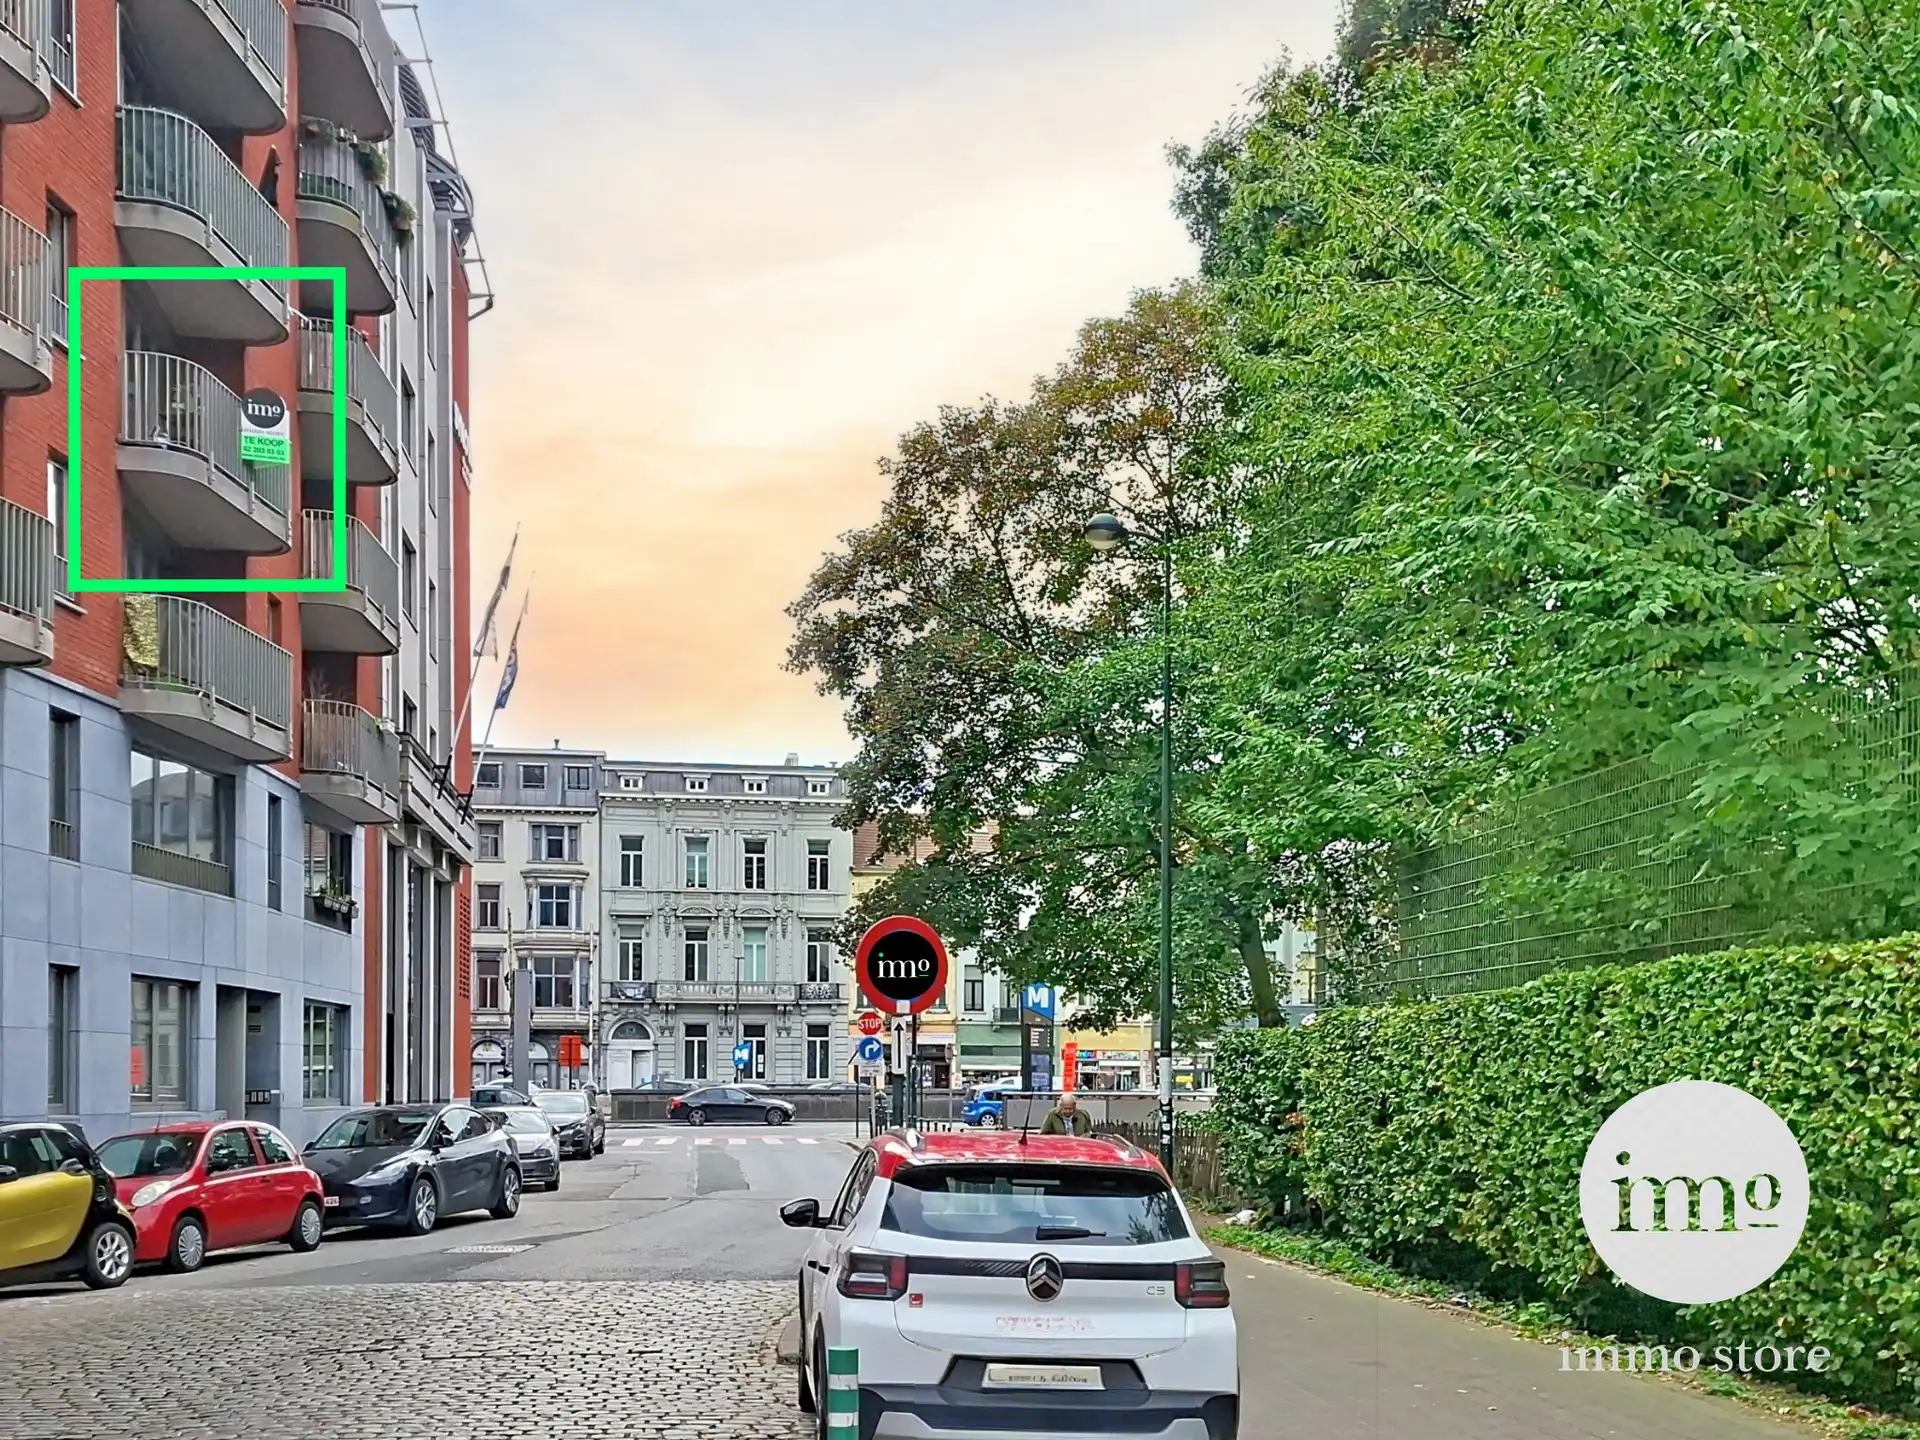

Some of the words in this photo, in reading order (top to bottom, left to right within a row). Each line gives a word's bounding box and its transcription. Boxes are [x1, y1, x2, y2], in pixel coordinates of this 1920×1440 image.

[243, 435, 256, 445] TE
[257, 438, 285, 447] KOOP
[1027, 986, 1049, 1008] M
[858, 1017, 881, 1030] STOP
